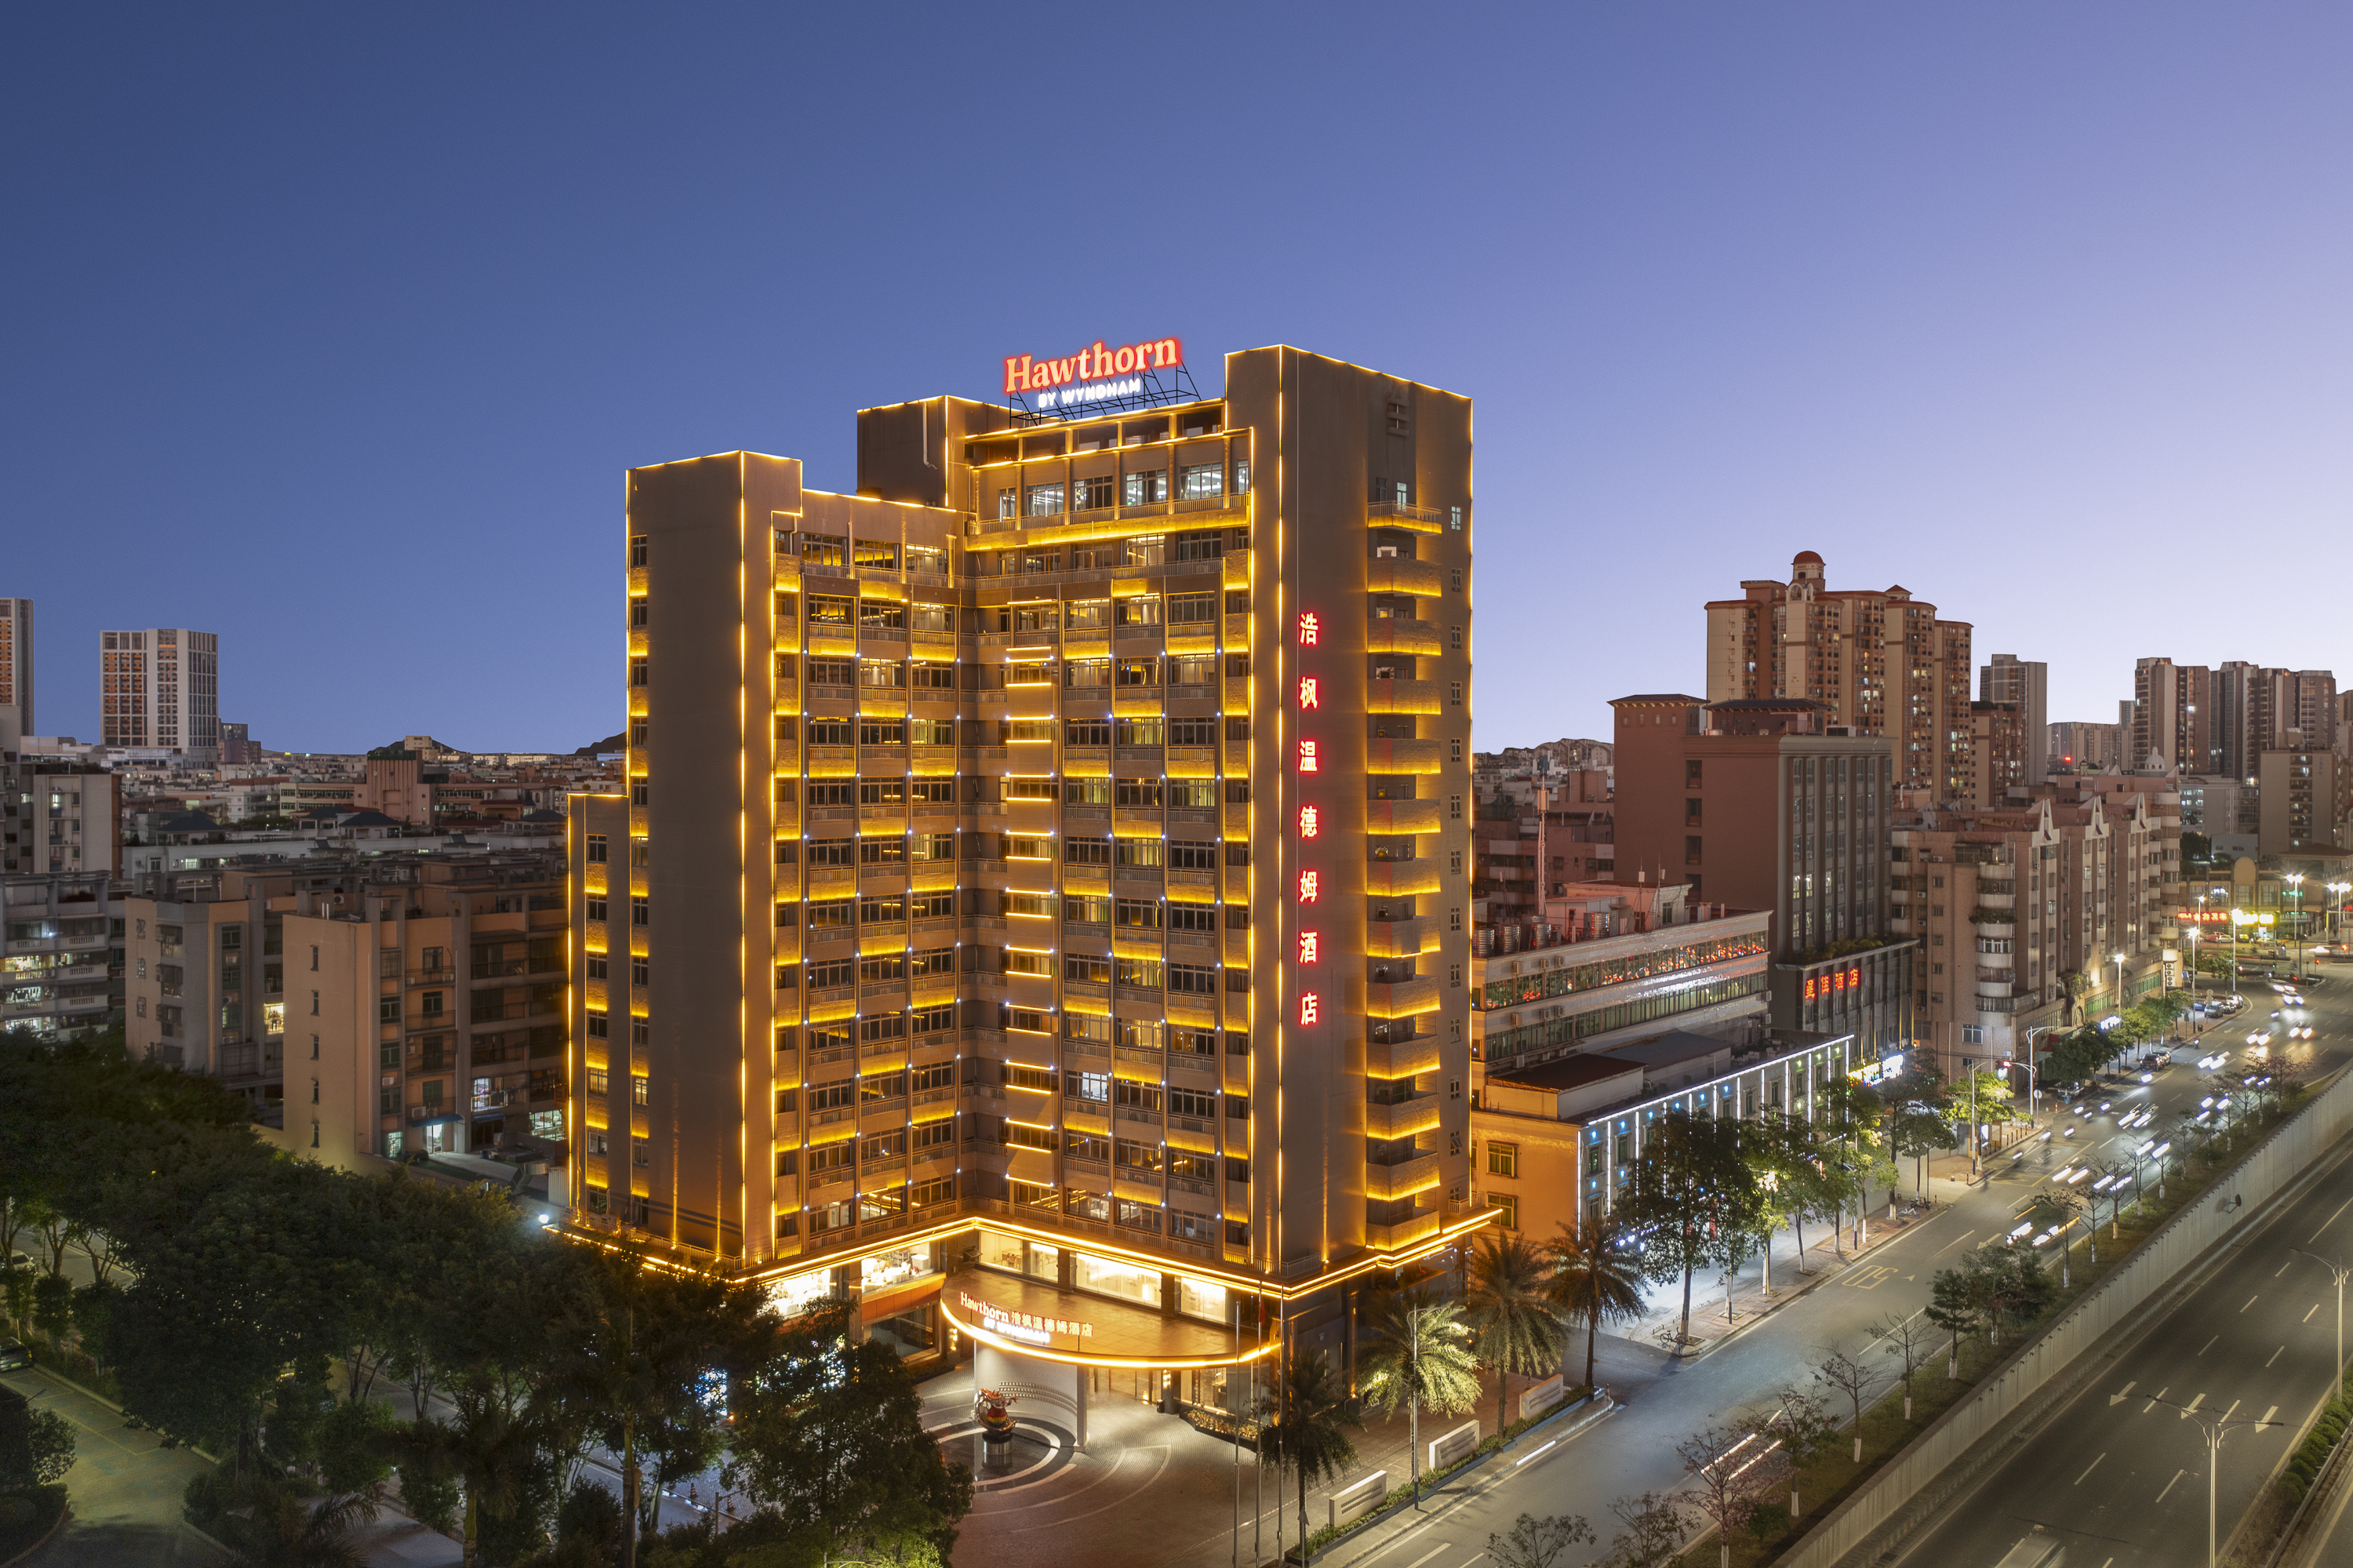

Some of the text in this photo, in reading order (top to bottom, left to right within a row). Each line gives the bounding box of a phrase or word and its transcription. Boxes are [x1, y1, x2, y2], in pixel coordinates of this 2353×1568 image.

[1006, 338, 1179, 393] Hawthorn
[1038, 377, 1141, 408] BY WYNDHAM
[1299, 612, 1318, 1025] 浩枫温德姆酒店
[960, 1291, 1009, 1322] Hawthorn
[1011, 1311, 1093, 1337] 浩枫温德姆酒店
